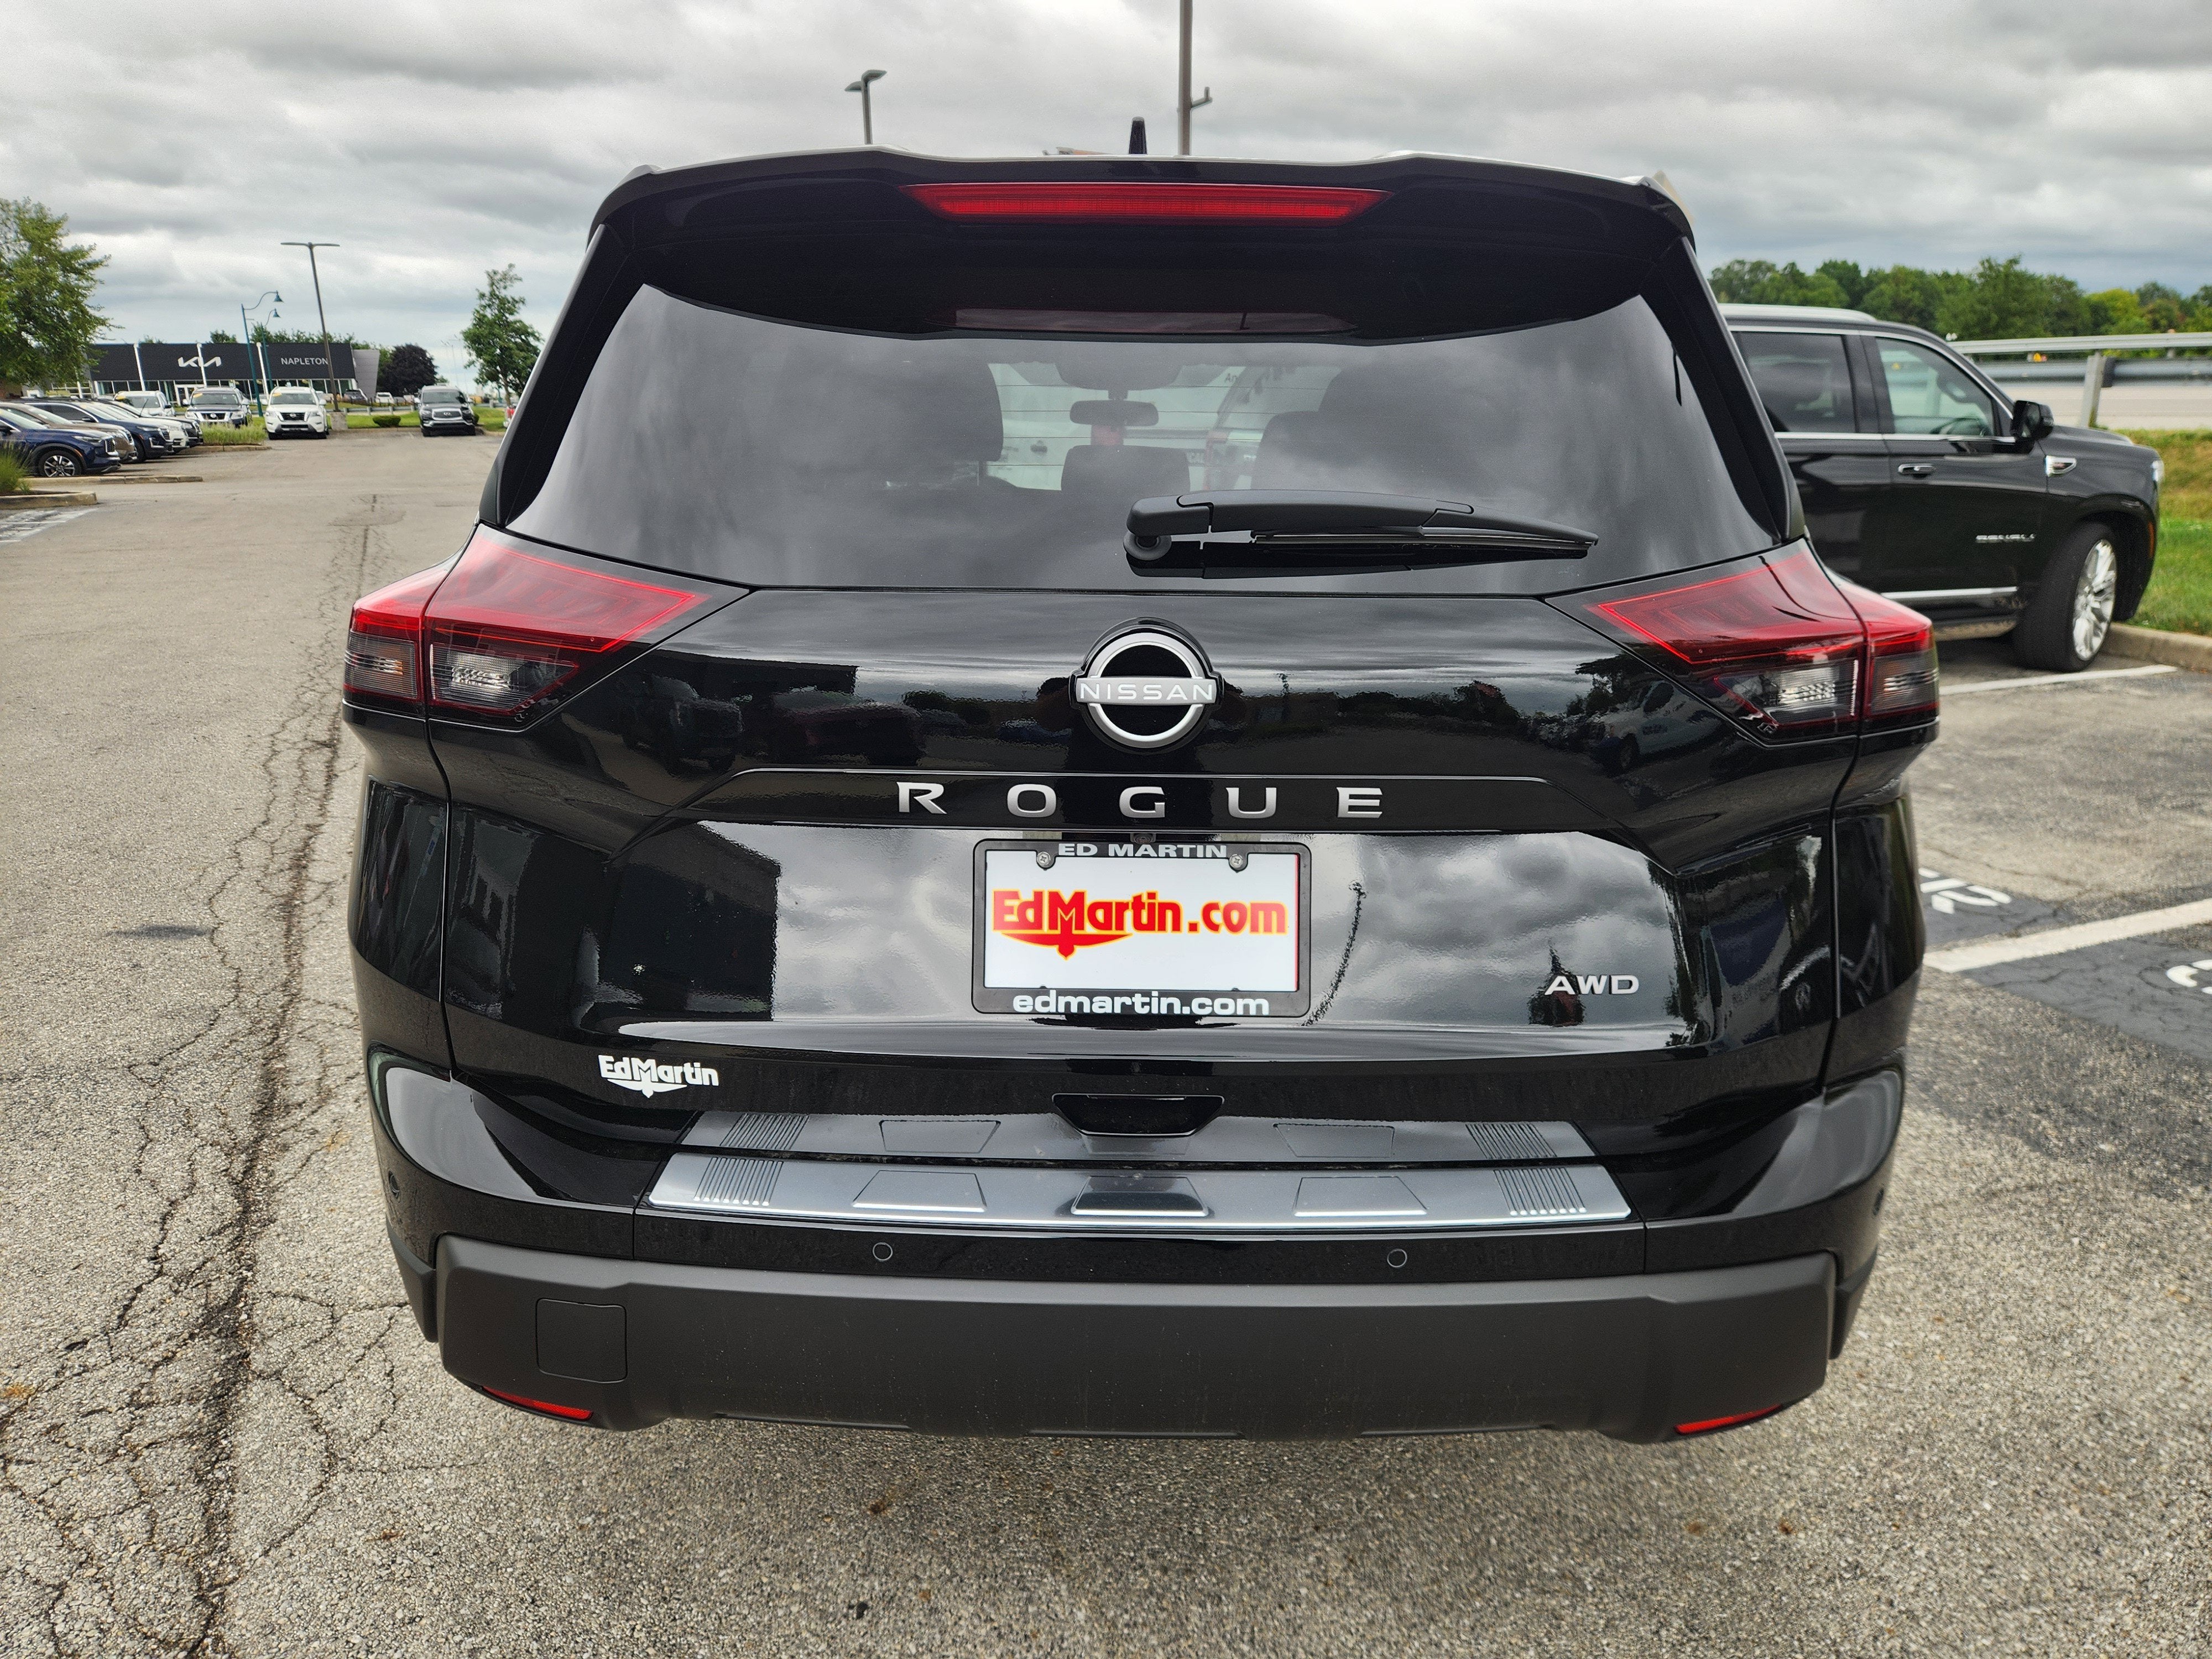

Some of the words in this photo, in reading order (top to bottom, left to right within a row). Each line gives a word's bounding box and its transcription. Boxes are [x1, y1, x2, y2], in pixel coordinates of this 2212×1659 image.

[1080, 682, 1213, 701] NISSAN
[896, 781, 1383, 818] ROGUE
[1058, 843, 1098, 855] ED
[1108, 843, 1227, 858] MARTIN
[993, 889, 1289, 936] EdMartin.com
[1545, 974, 1639, 995] AWD
[1013, 989, 1270, 1016] edmartin.com
[598, 1055, 719, 1087] EdMartin
